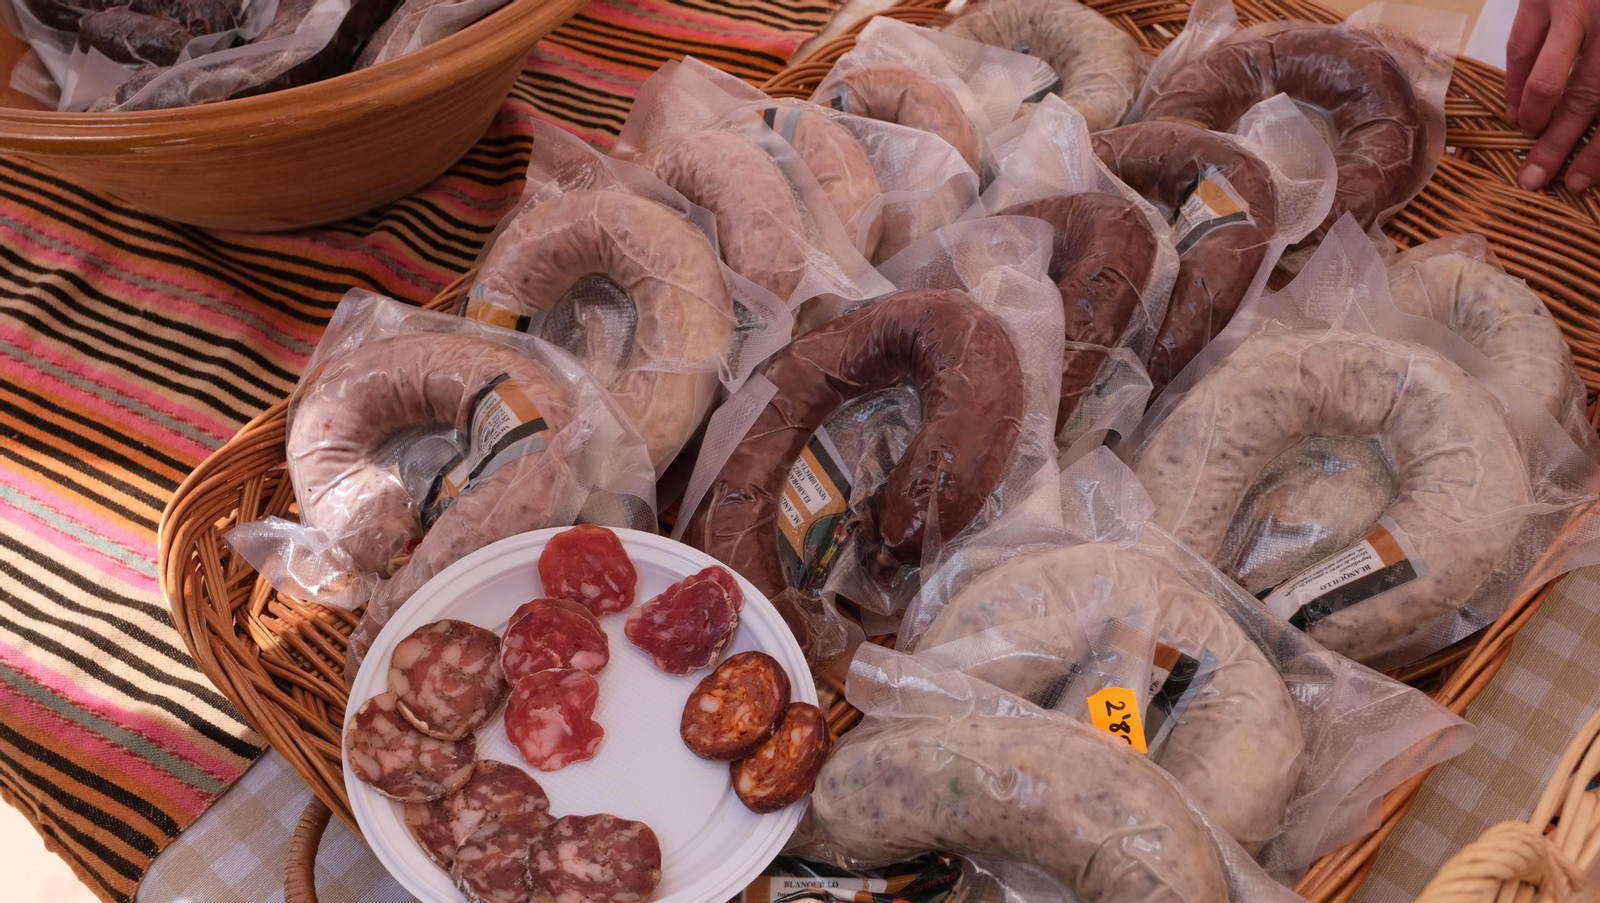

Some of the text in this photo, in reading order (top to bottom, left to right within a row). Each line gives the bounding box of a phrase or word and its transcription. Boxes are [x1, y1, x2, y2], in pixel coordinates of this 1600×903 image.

[791, 464, 805, 481] CH/2
[799, 462, 817, 485] DIRECTA
[813, 482, 827, 500] VENTA
[1318, 563, 1370, 591] BLANQUILLO
